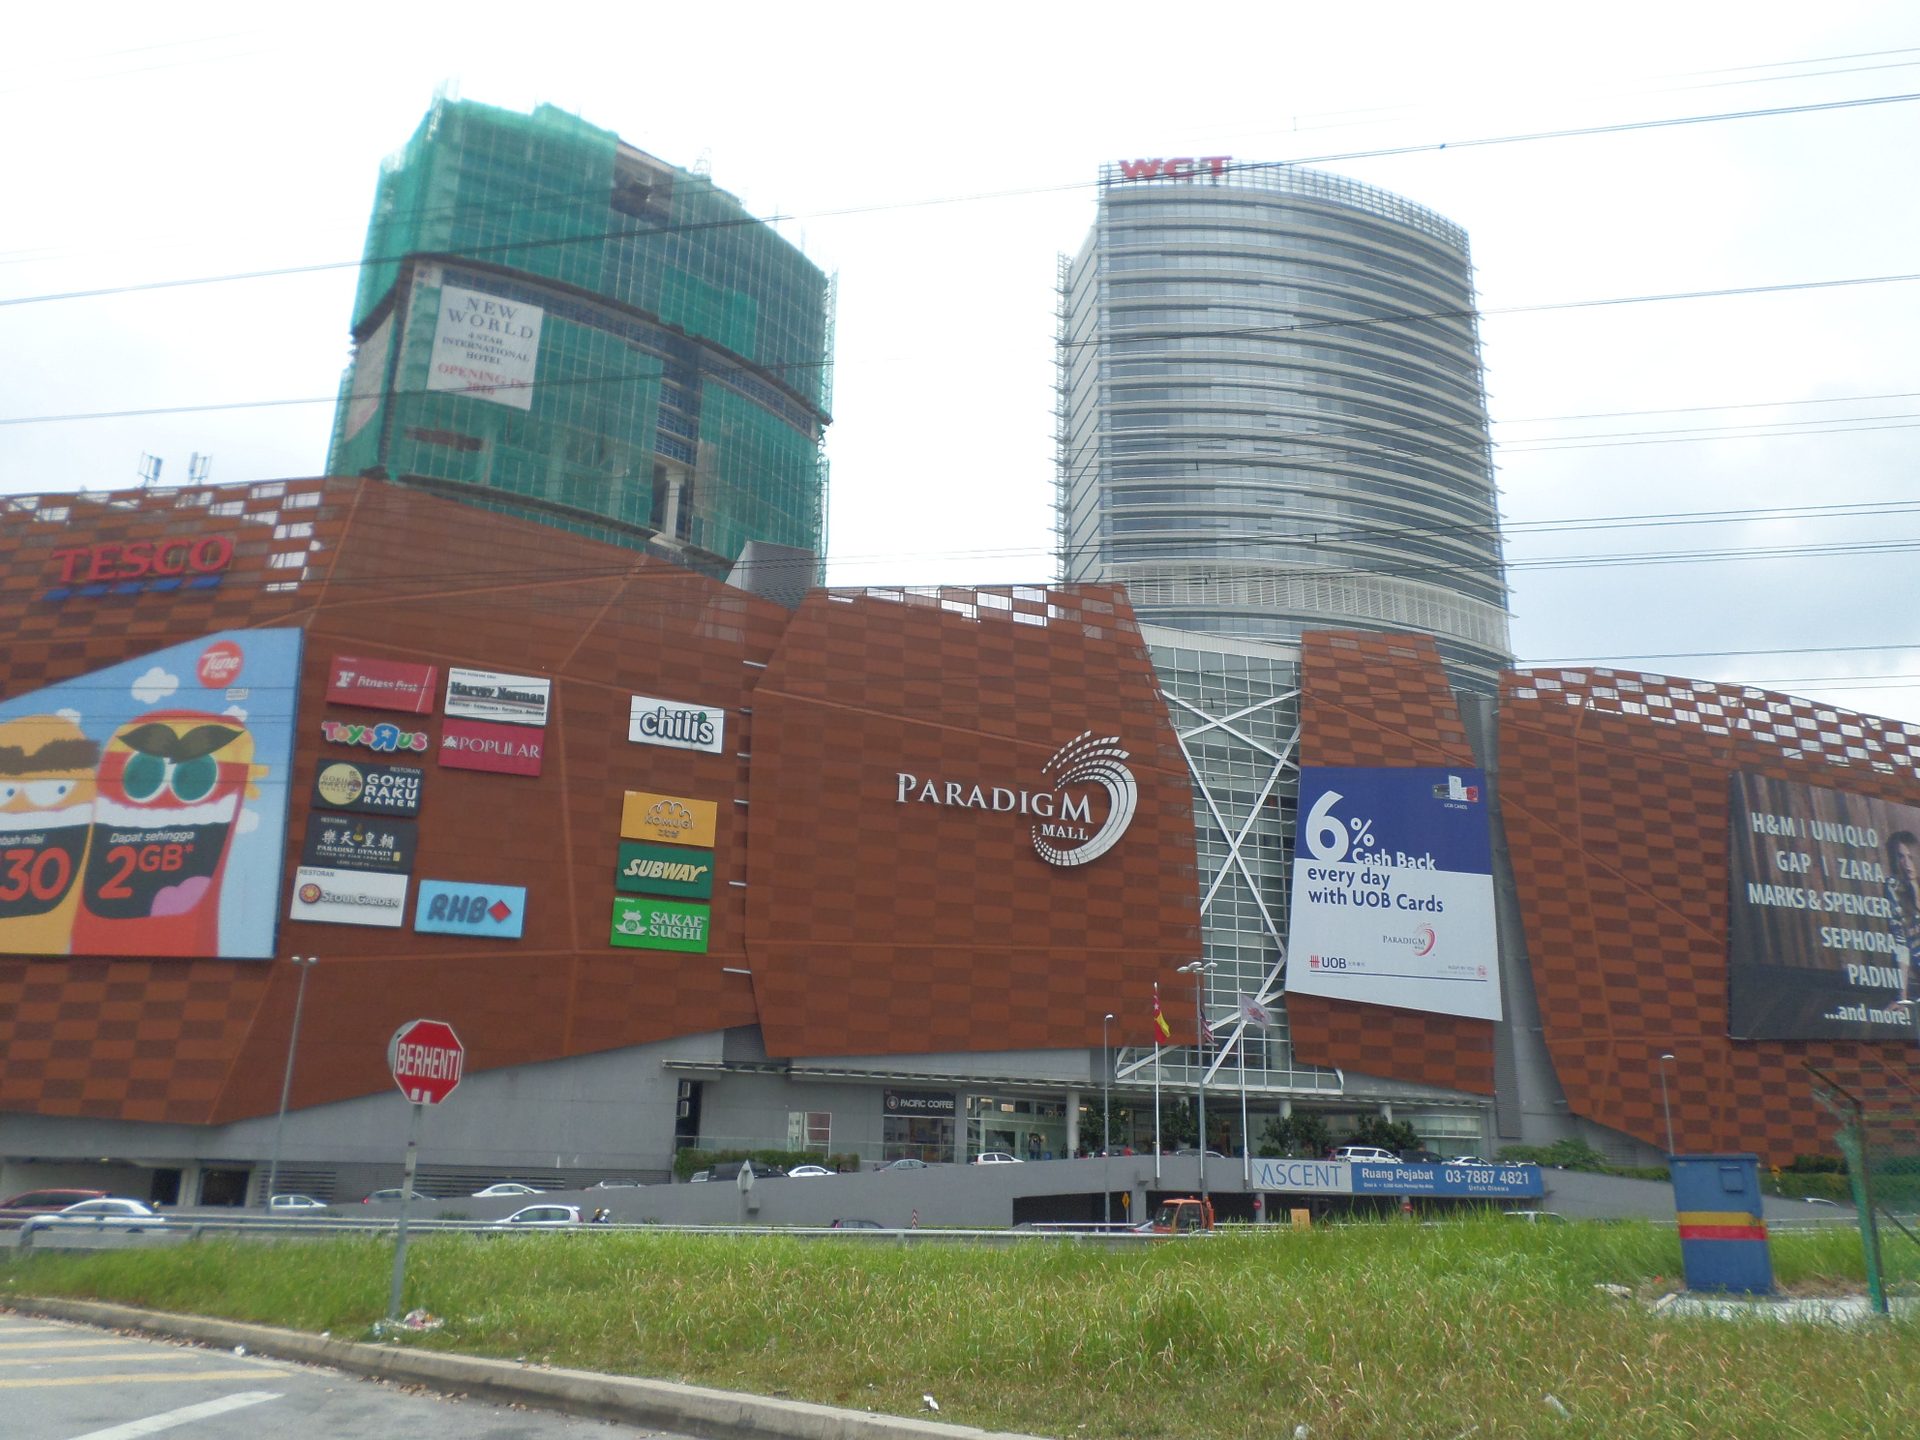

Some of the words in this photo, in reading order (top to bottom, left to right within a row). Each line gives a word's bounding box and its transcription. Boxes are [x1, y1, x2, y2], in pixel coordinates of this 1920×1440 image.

[1118, 155, 1233, 179] WCT
[466, 296, 517, 319] NEW
[448, 308, 533, 339] WORLD
[442, 336, 530, 362] INTERNATIONAL
[466, 351, 502, 365] HOTEL
[437, 362, 505, 385] OPENING
[52, 535, 233, 583] TESCO
[201, 651, 240, 677] Tune
[450, 681, 495, 698] Harvey
[497, 686, 545, 704] Norman
[459, 736, 540, 759] POPULAR
[366, 773, 419, 789] GOKU
[390, 766, 421, 775] RESTORAN
[363, 796, 415, 808] RAMEN
[365, 785, 417, 800] RAKU
[896, 772, 1094, 824] PARADIGM
[0, 834, 21, 846] bah
[109, 832, 142, 845] Dapat
[144, 830, 195, 843] sehingga
[1042, 823, 1089, 841] MALL
[1751, 812, 1796, 837] H&M
[1810, 820, 1879, 848] UNIQLO
[317, 844, 355, 854] PARADISE
[357, 848, 392, 857] DYNASTY
[1352, 847, 1392, 868] Cash
[1397, 851, 1437, 871] Back
[299, 869, 335, 877] RESTORAN
[623, 859, 708, 882] SUBWAY
[1307, 866, 1355, 889] every
[1361, 866, 1390, 890] day
[1776, 850, 1812, 874] GAP
[1837, 858, 1886, 884] ZARA
[427, 893, 489, 924] RHB
[1308, 886, 1347, 906] with
[1353, 890, 1391, 909] UOB
[1397, 893, 1444, 913] Cards
[1748, 883, 1806, 909] MARKS
[1807, 889, 1821, 911] &
[1823, 891, 1893, 918] SPENCER
[651, 911, 703, 928] SAKAE
[649, 924, 703, 941] SUSHI
[1383, 935, 1426, 946] PARADIGM
[1821, 926, 1897, 954] SEPHORA
[1321, 956, 1347, 970] UOB
[1870, 1007, 1912, 1026] more!
[397, 1043, 460, 1081] BERHENTI
[901, 1098, 926, 1108] PACIFIC
[927, 1100, 954, 1109] COFFEE
[1260, 1163, 1343, 1188] ASCENT
[1362, 1168, 1394, 1181] Ruang
[1396, 1168, 1434, 1181] Pejabat
[1445, 1169, 1495, 1184] 03-7887
[1499, 1170, 1529, 1185] 4821
